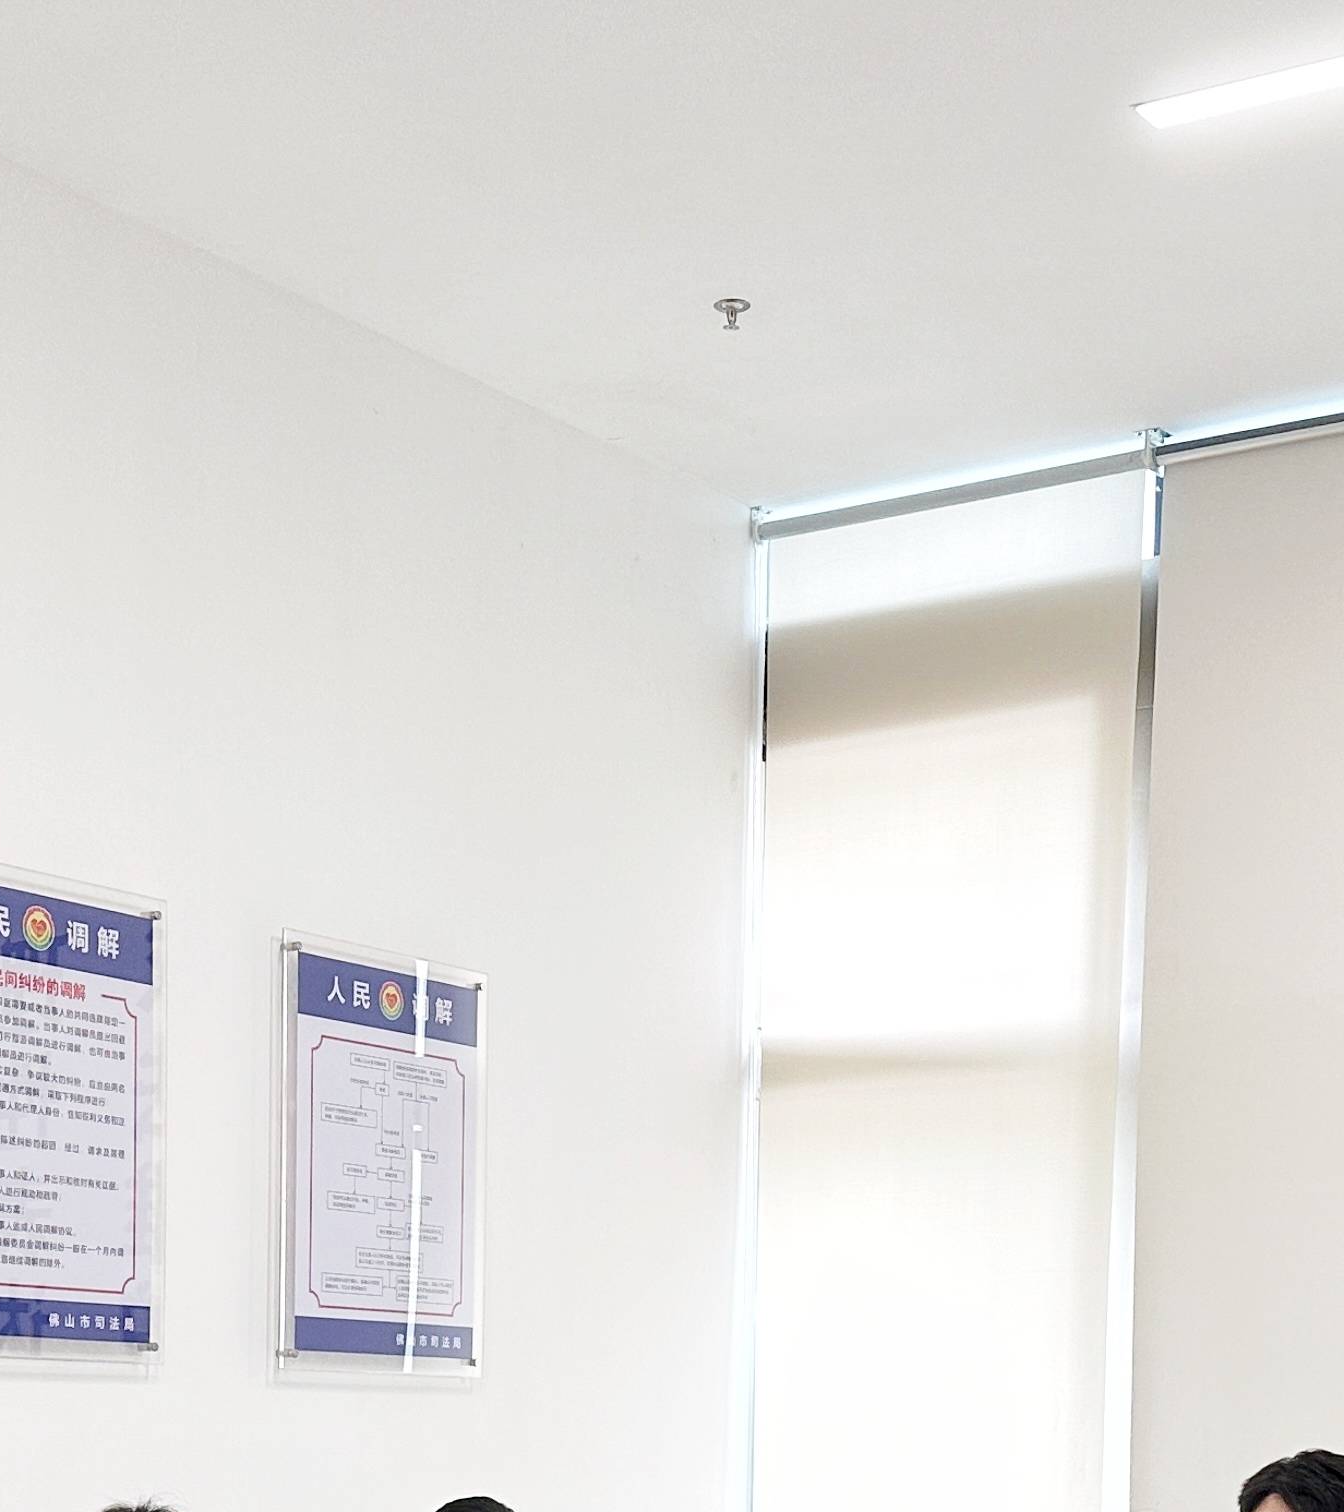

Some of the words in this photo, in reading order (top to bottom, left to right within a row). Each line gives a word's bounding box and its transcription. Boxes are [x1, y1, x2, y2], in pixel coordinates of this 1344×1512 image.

[67, 920, 120, 960] 调解
[327, 976, 371, 1010] 人民
[49, 1312, 136, 1332] 佛山市司法局
[396, 1333, 462, 1349] 佛市司法局
